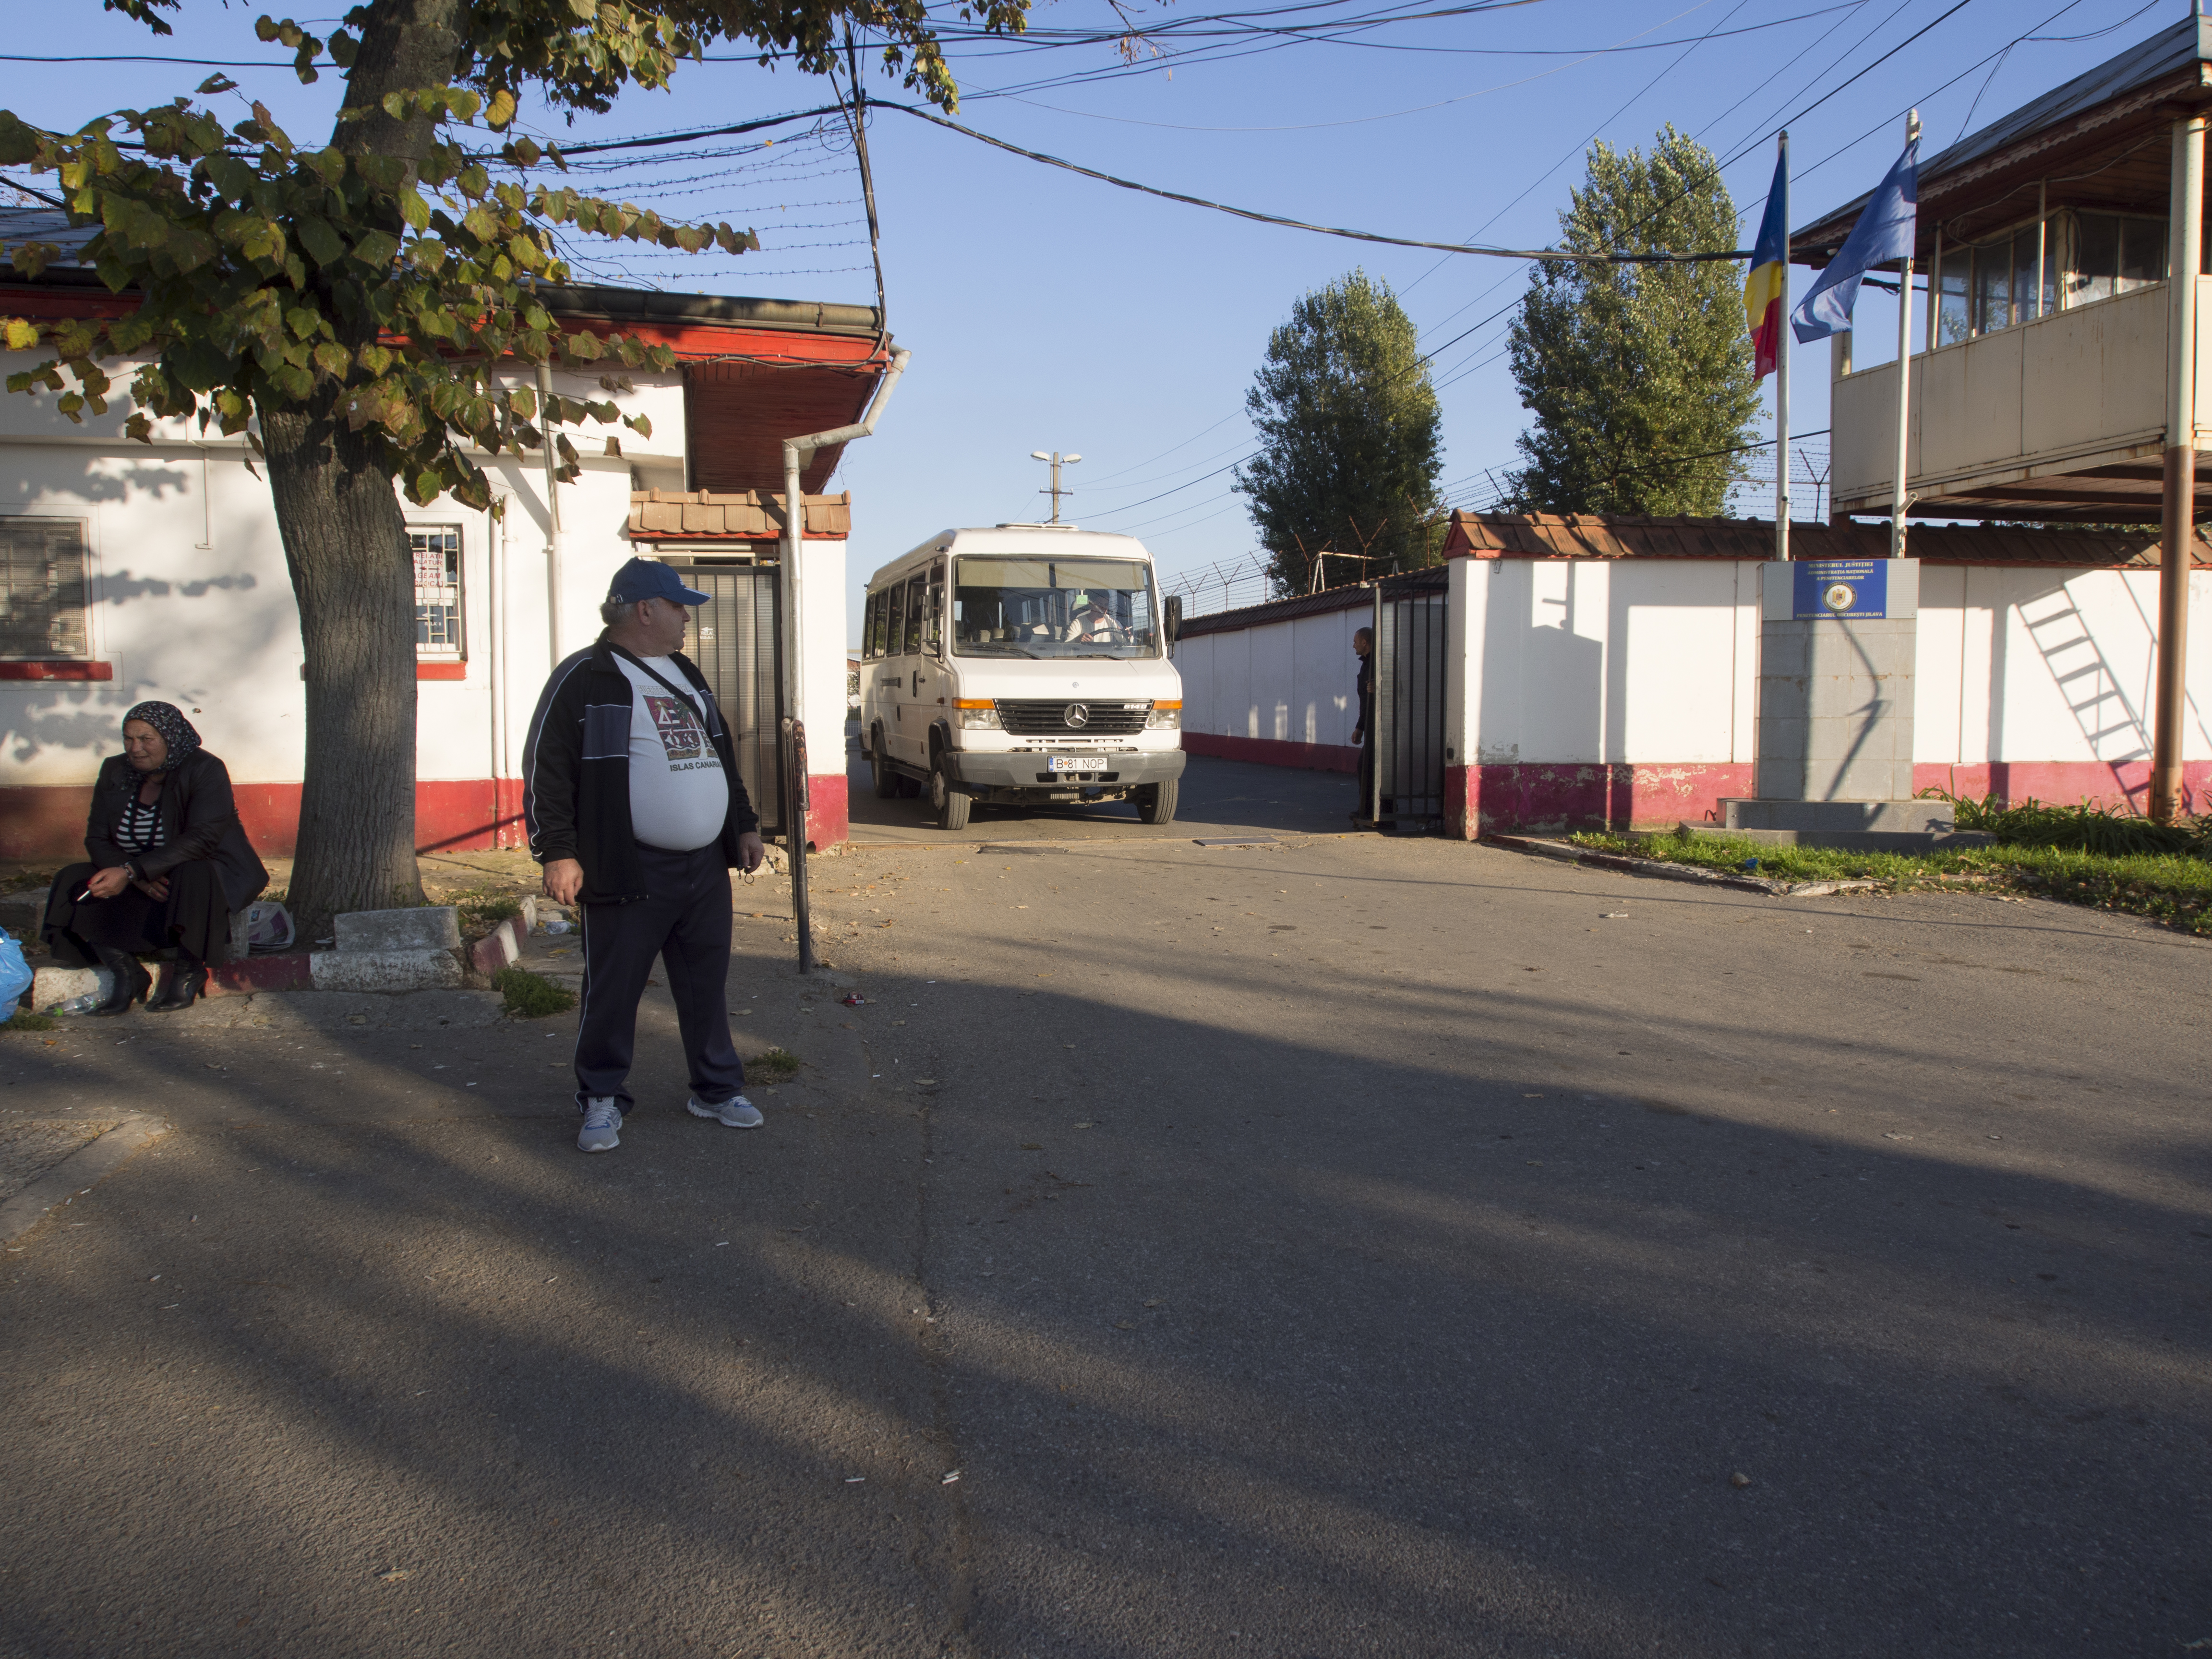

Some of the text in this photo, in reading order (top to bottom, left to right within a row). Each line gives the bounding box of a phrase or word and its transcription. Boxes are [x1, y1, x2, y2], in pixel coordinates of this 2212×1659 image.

[636, 683, 693, 695] FUERTEVURA
[670, 762, 694, 771] ISLAS
[1057, 759, 1104, 769] B 81 NOP
